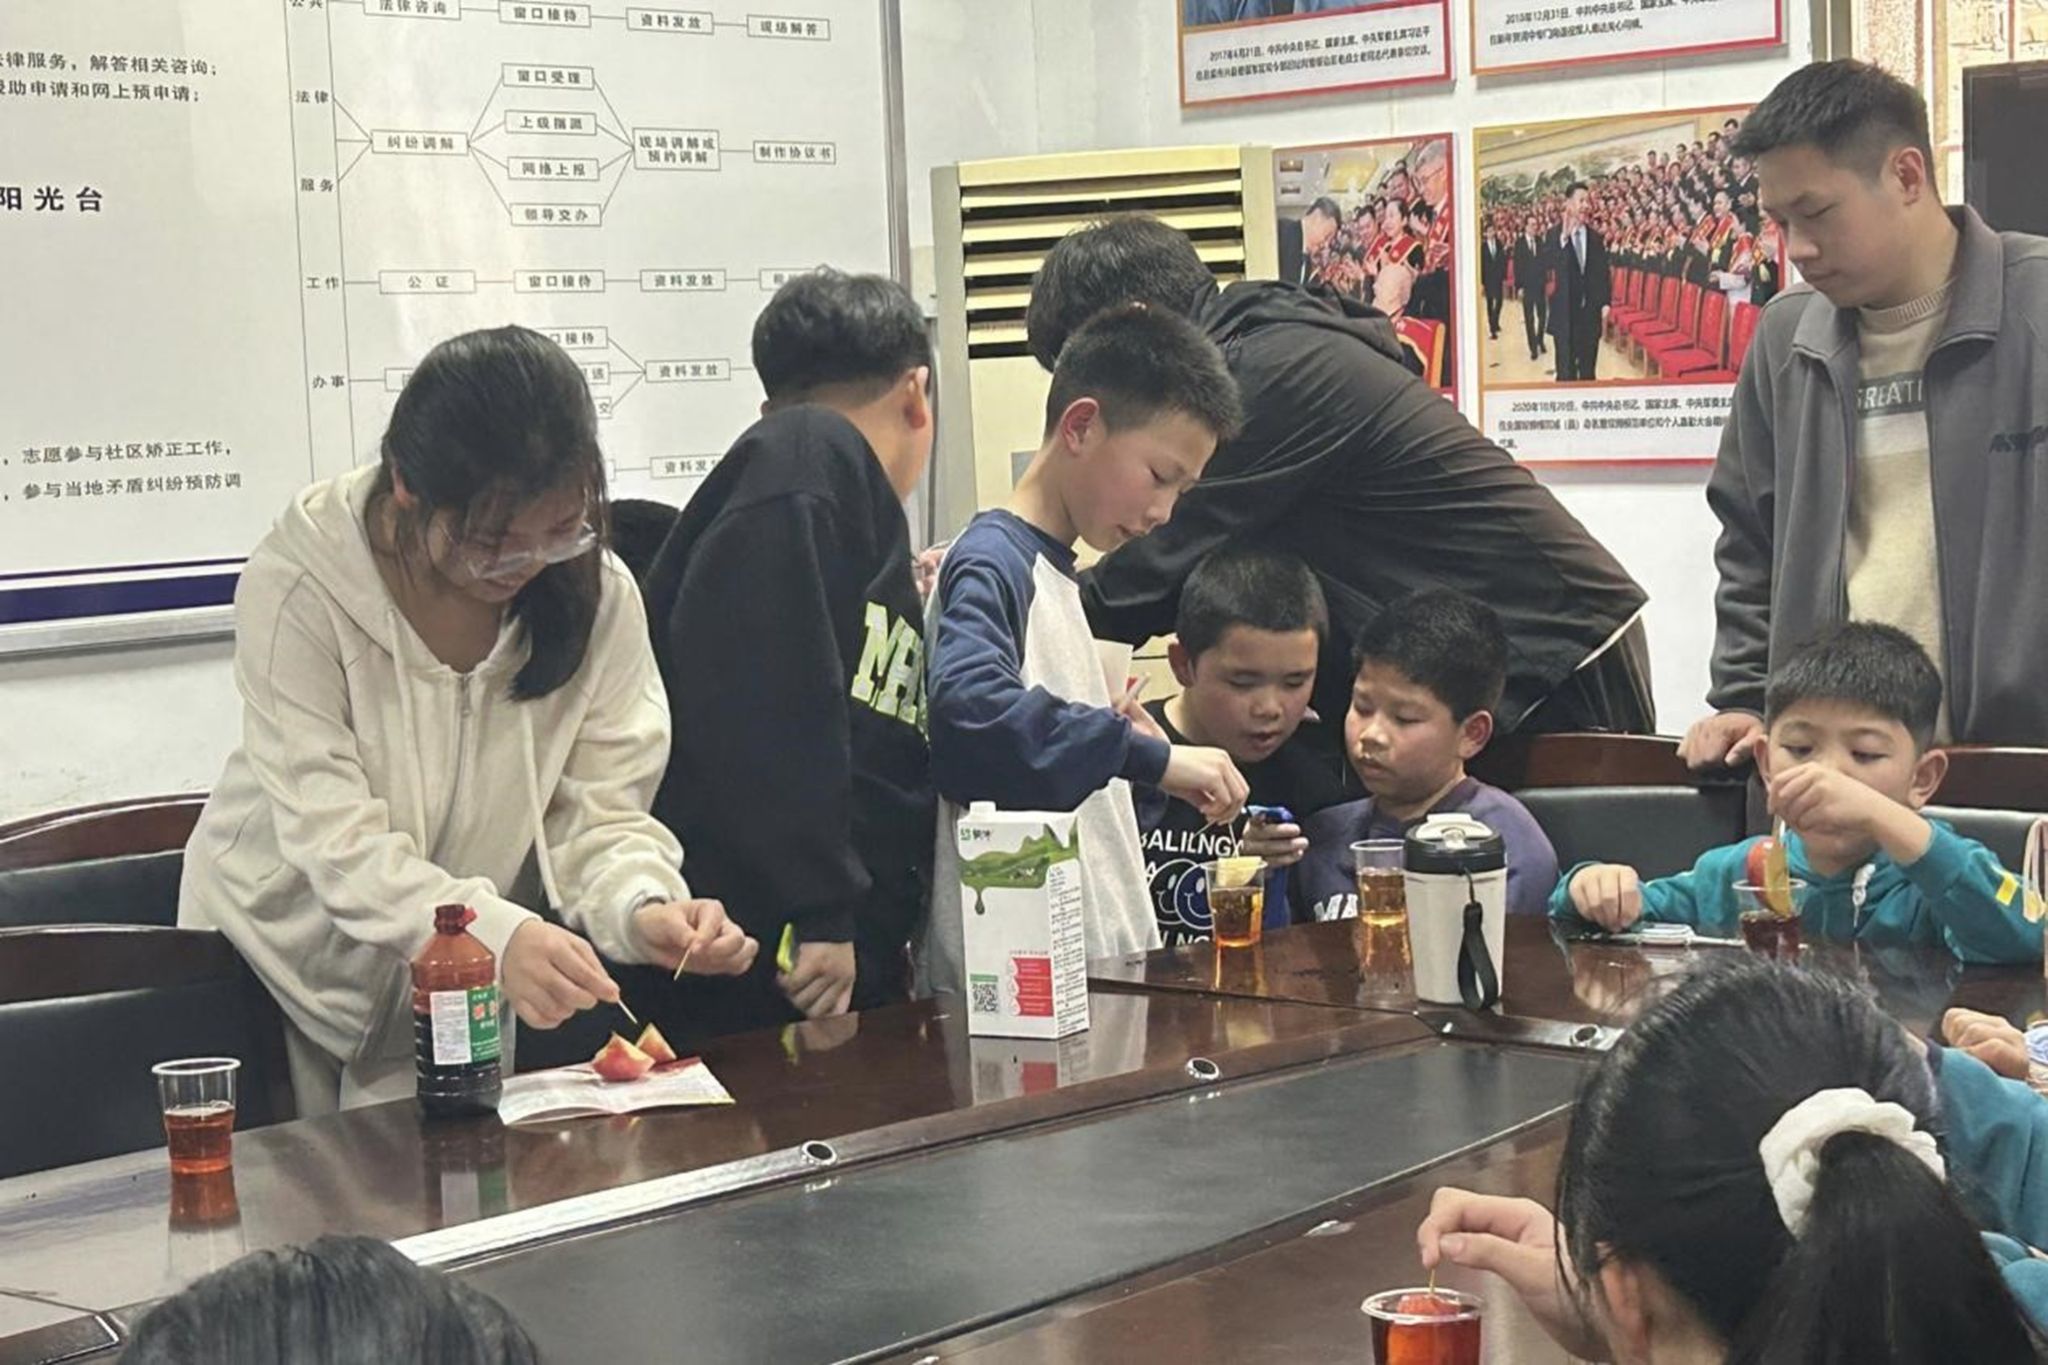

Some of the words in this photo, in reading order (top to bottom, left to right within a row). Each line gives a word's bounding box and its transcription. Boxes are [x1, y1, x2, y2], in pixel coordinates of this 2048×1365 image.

[379, 0, 447, 15] 法律咨询
[513, 6, 577, 23] 窗口接待
[640, 14, 702, 30] 资料发放
[517, 70, 581, 84] 窗口受理
[0, 79, 199, 102] 助申请和网上预申请；
[296, 90, 329, 104] 法律
[387, 136, 455, 151] 纠纷调解
[759, 146, 831, 160] 制作协议书
[522, 162, 586, 176] 网络上报
[300, 178, 334, 193] 服务
[0, 186, 102, 212] 阳光台
[525, 209, 588, 222] 领导交办
[306, 276, 339, 290] 工作
[408, 275, 450, 289] 公证
[528, 274, 592, 288] 窗口接待
[654, 273, 713, 288] 资料发放
[659, 364, 719, 378] 资料发放
[312, 375, 345, 389] 办事
[665, 459, 716, 474] 资料发
[851, 601, 930, 742] MH
